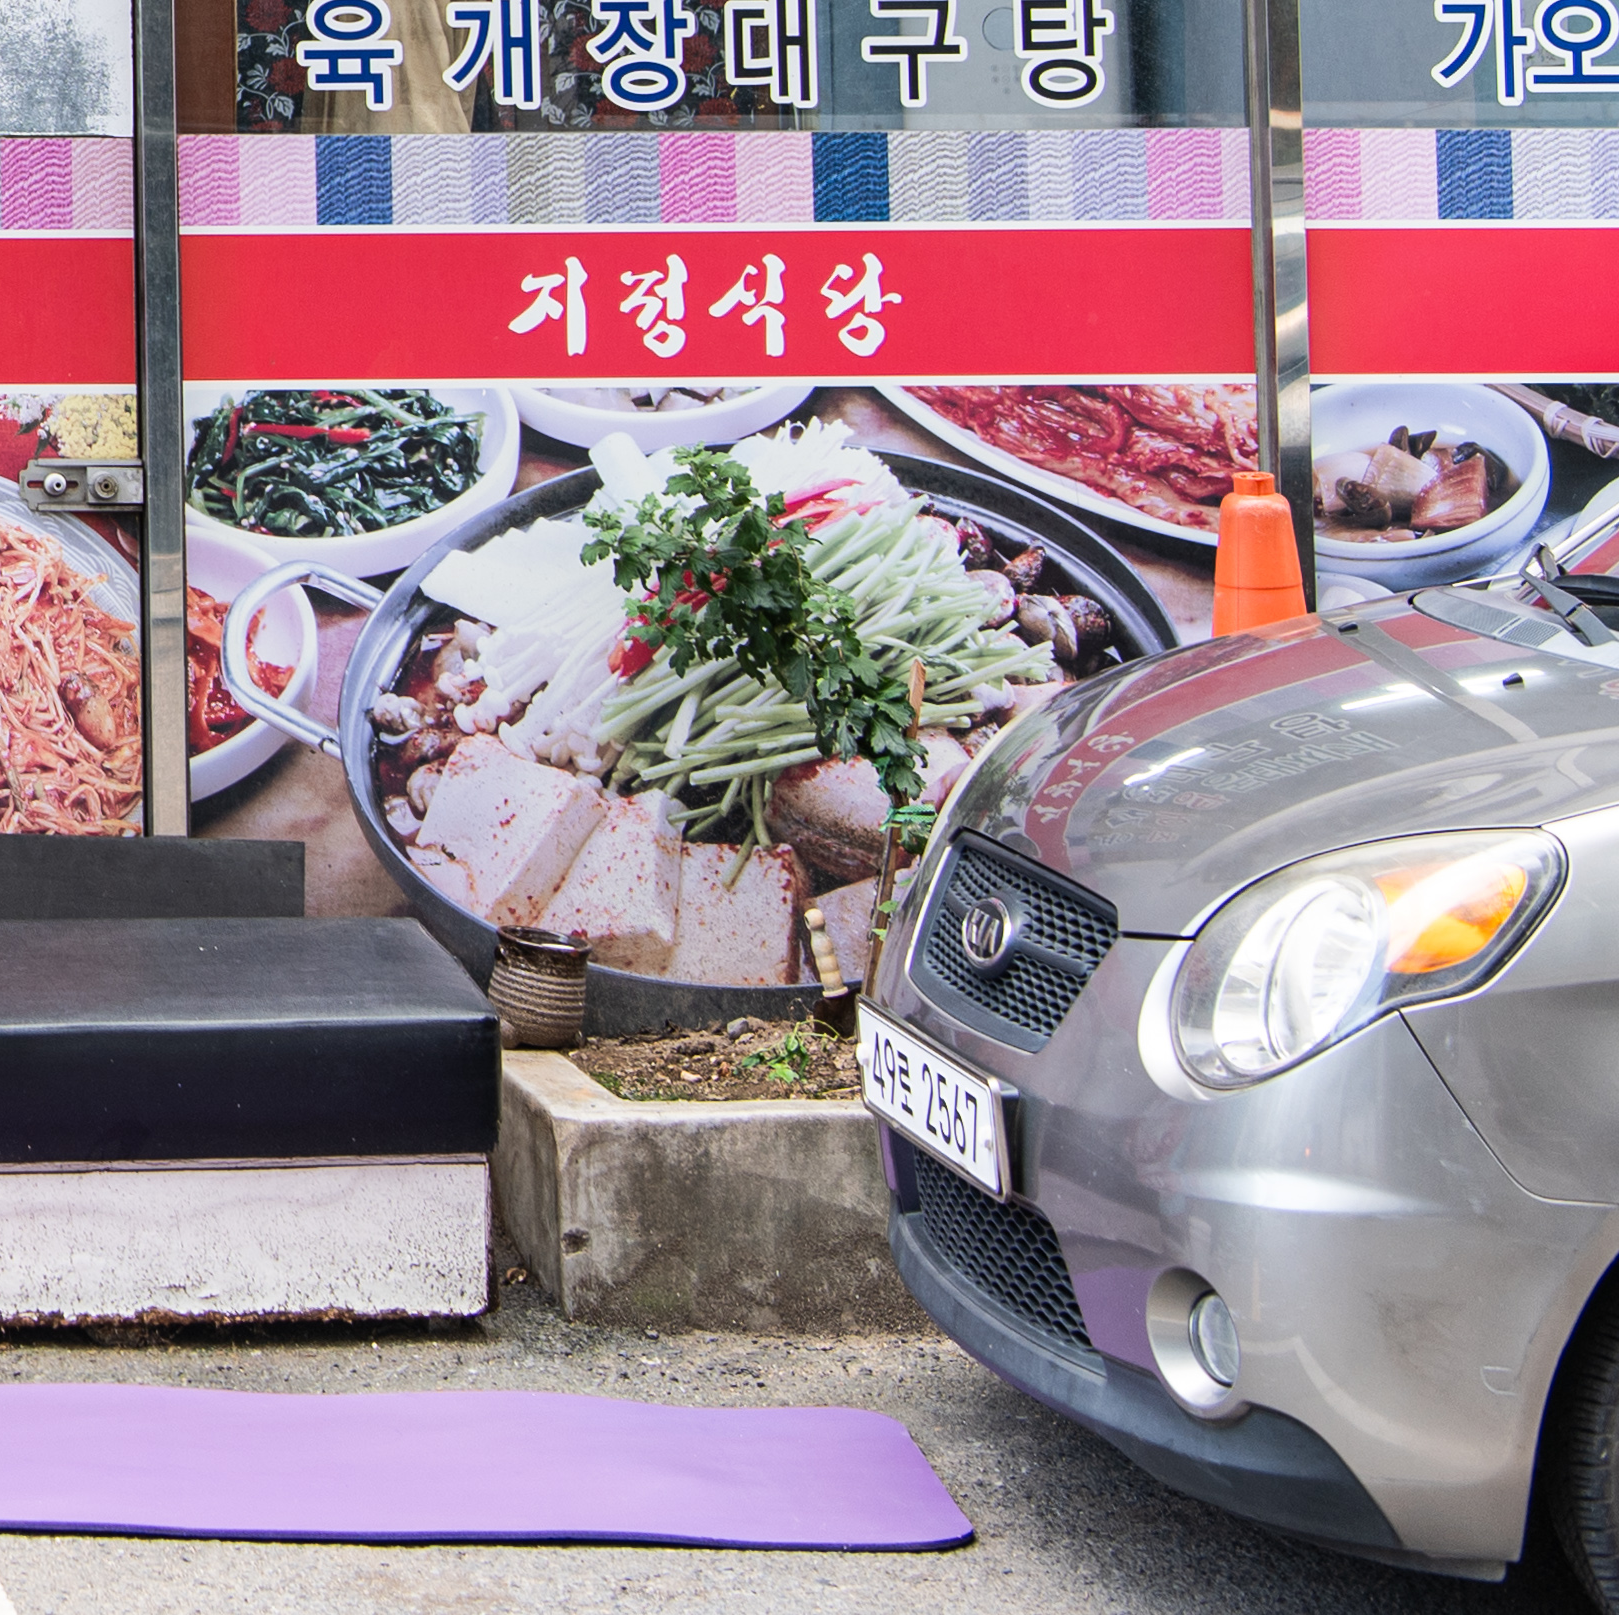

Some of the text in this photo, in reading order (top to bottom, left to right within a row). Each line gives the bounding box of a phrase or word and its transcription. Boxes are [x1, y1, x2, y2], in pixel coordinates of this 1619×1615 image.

[509, 253, 901, 357] 지정식당
[873, 1031, 978, 1163] 49로 2567
